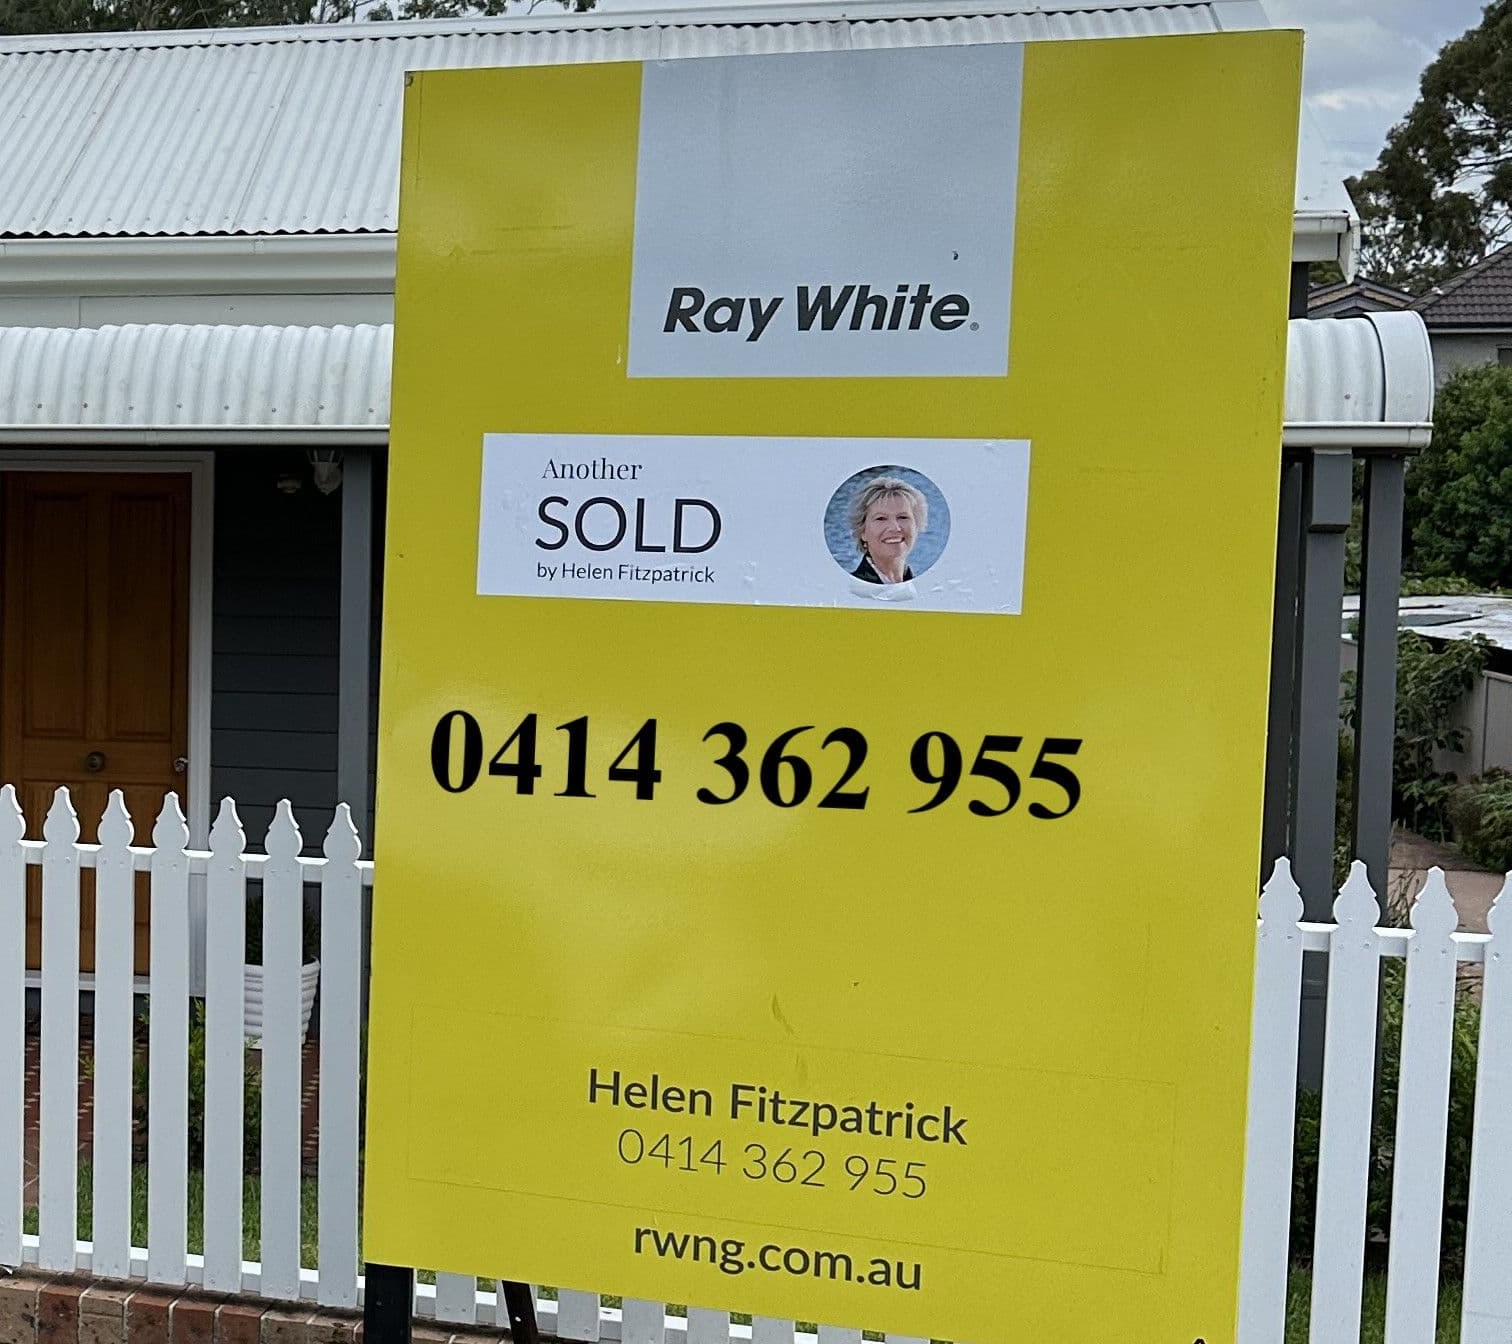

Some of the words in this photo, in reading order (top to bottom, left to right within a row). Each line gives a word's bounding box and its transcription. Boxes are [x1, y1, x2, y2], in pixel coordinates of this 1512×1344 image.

[662, 287, 785, 342] Ray
[541, 457, 643, 481] Another
[535, 495, 722, 554] SOLD
[537, 562, 558, 582] by
[561, 562, 613, 580] Helen
[618, 564, 716, 585] Fitzpatrick
[430, 709, 662, 801] 0414
[696, 721, 870, 810] 362
[907, 730, 1083, 820] 955
[589, 1068, 712, 1117] Helen
[730, 1083, 969, 1146] Fitzpatrick
[618, 1128, 728, 1175] 0414
[742, 1143, 826, 1188] 362
[844, 1155, 927, 1199] 955
[634, 1227, 921, 1291] rwng.com.au
